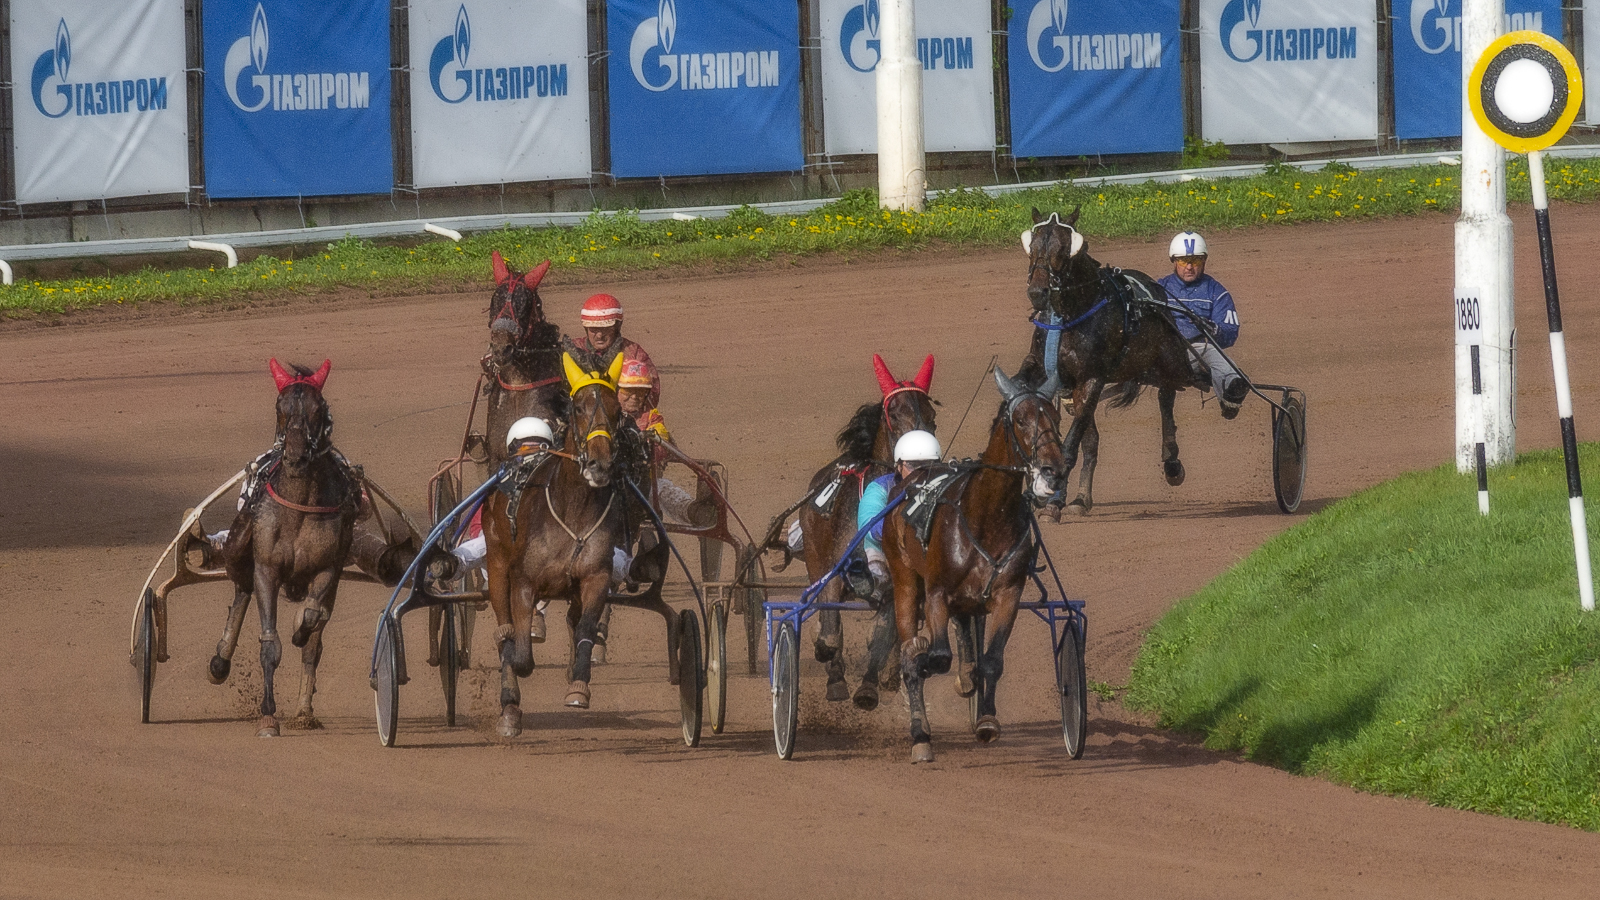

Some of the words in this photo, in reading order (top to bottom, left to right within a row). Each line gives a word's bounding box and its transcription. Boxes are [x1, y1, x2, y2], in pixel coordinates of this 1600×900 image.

[917, 37, 973, 70] ПРОМ
[1073, 33, 1161, 71] ГАЗПРОМ
[1266, 27, 1356, 62] ГАЗПРОМ
[475, 65, 567, 102] ГАЗПРОМ
[681, 51, 778, 90] ГАЗПРОМ
[75, 77, 167, 116] ГАЗПРОМ
[273, 73, 368, 111] ГАЗПРОМ
[1457, 298, 1480, 330] 1880
